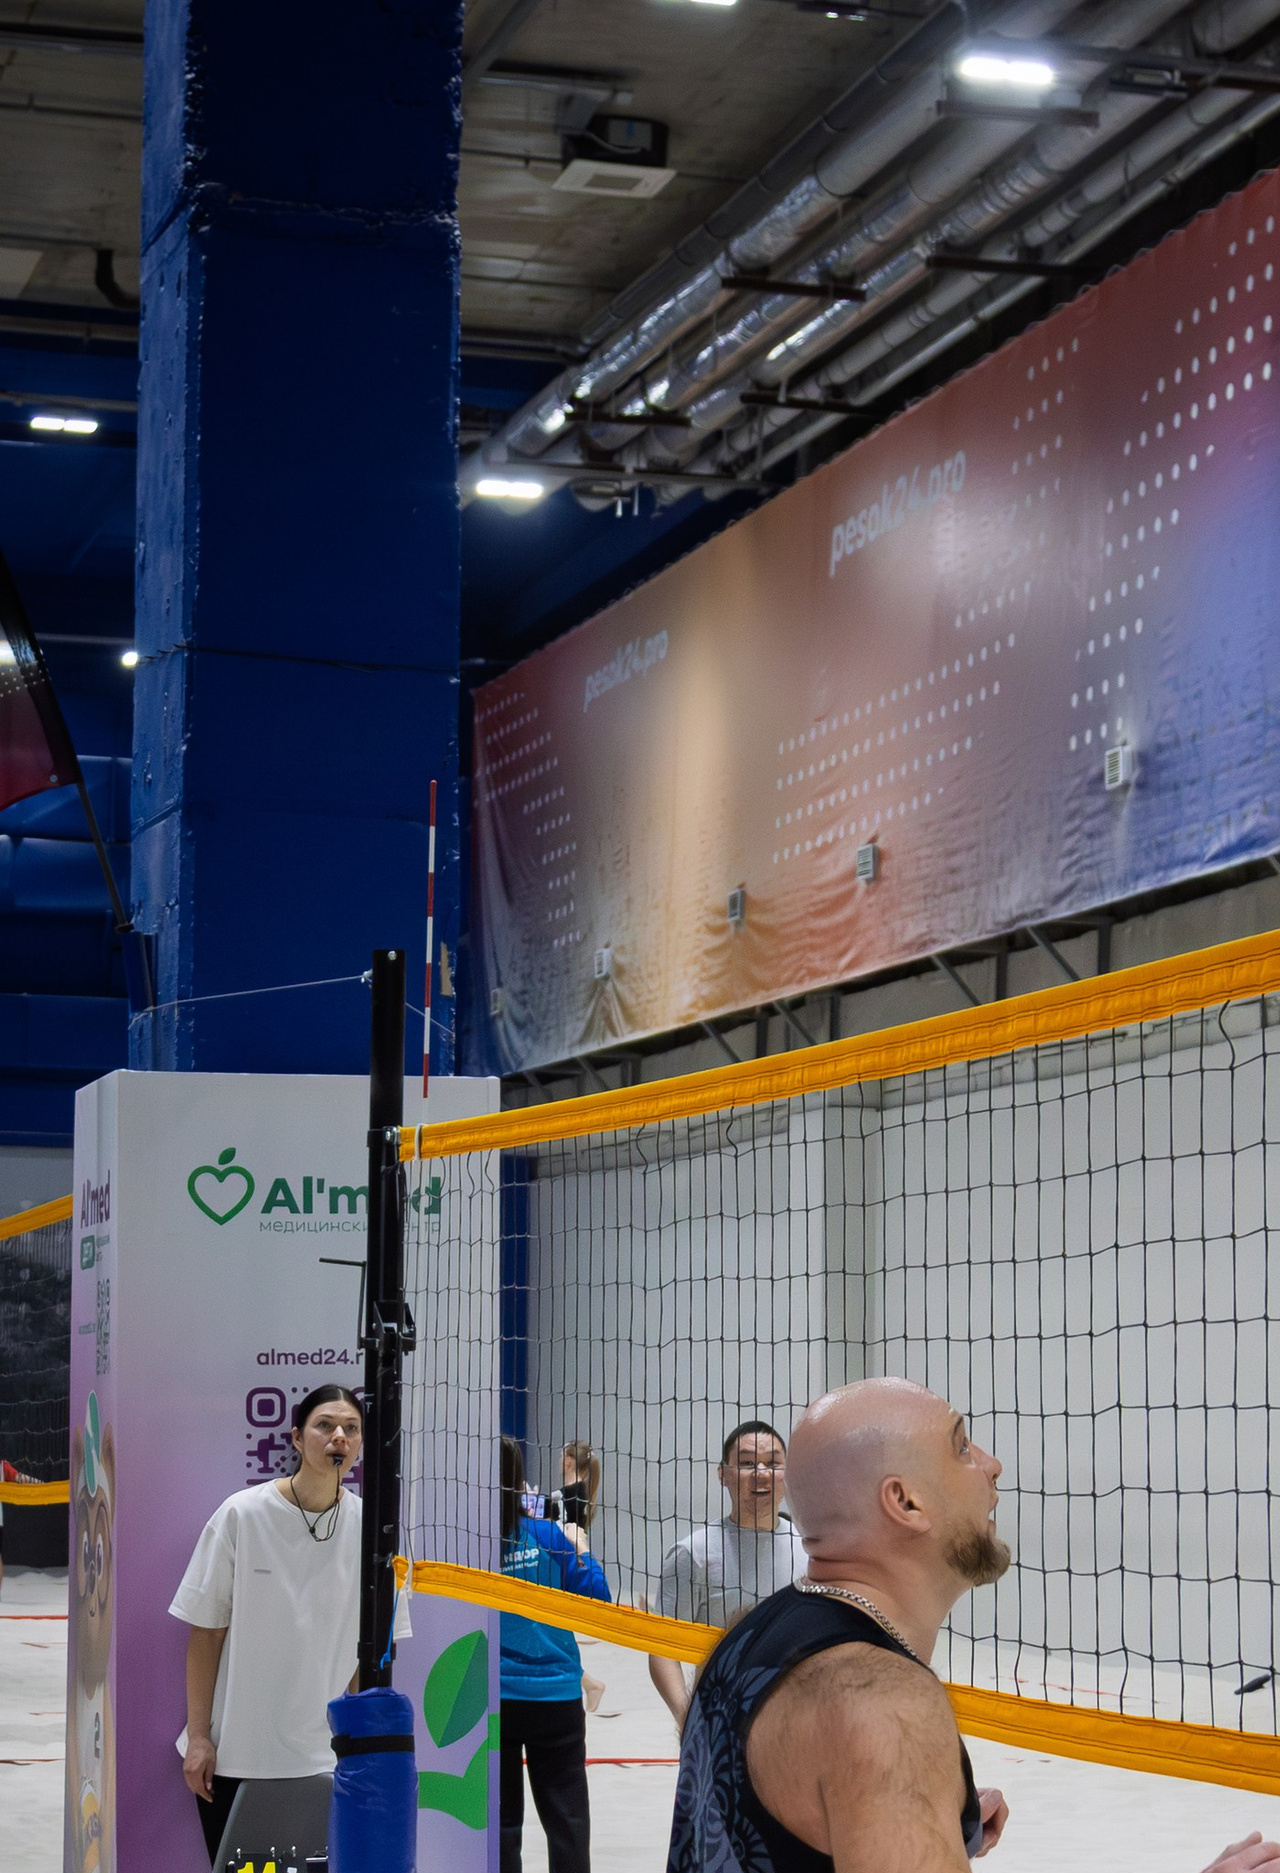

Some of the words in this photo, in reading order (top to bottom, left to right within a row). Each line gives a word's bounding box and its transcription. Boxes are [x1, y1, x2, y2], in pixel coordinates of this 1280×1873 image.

[829, 449, 967, 578] pesok24.pro
[260, 1175, 442, 1215] Al'md
[259, 1220, 369, 1234] медицински
[256, 1347, 365, 1366] almed24.r
